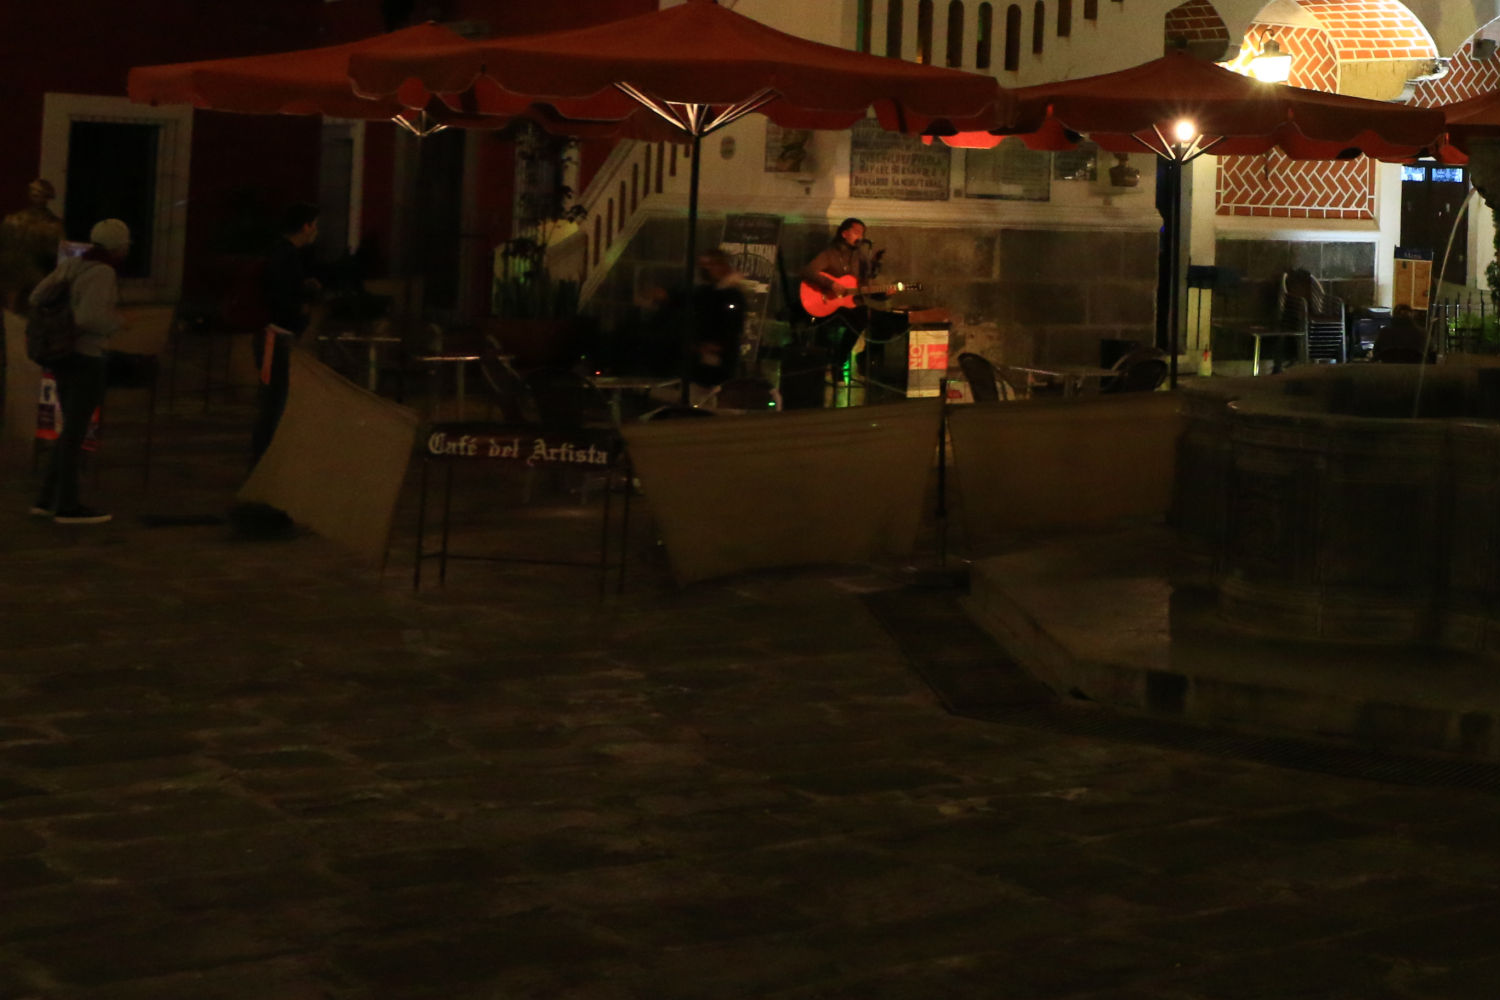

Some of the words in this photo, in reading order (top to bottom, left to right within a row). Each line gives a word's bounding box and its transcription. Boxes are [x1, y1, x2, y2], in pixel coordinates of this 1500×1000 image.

[428, 432, 478, 456] Café
[488, 438, 520, 458] del
[526, 437, 609, 467] Artista
